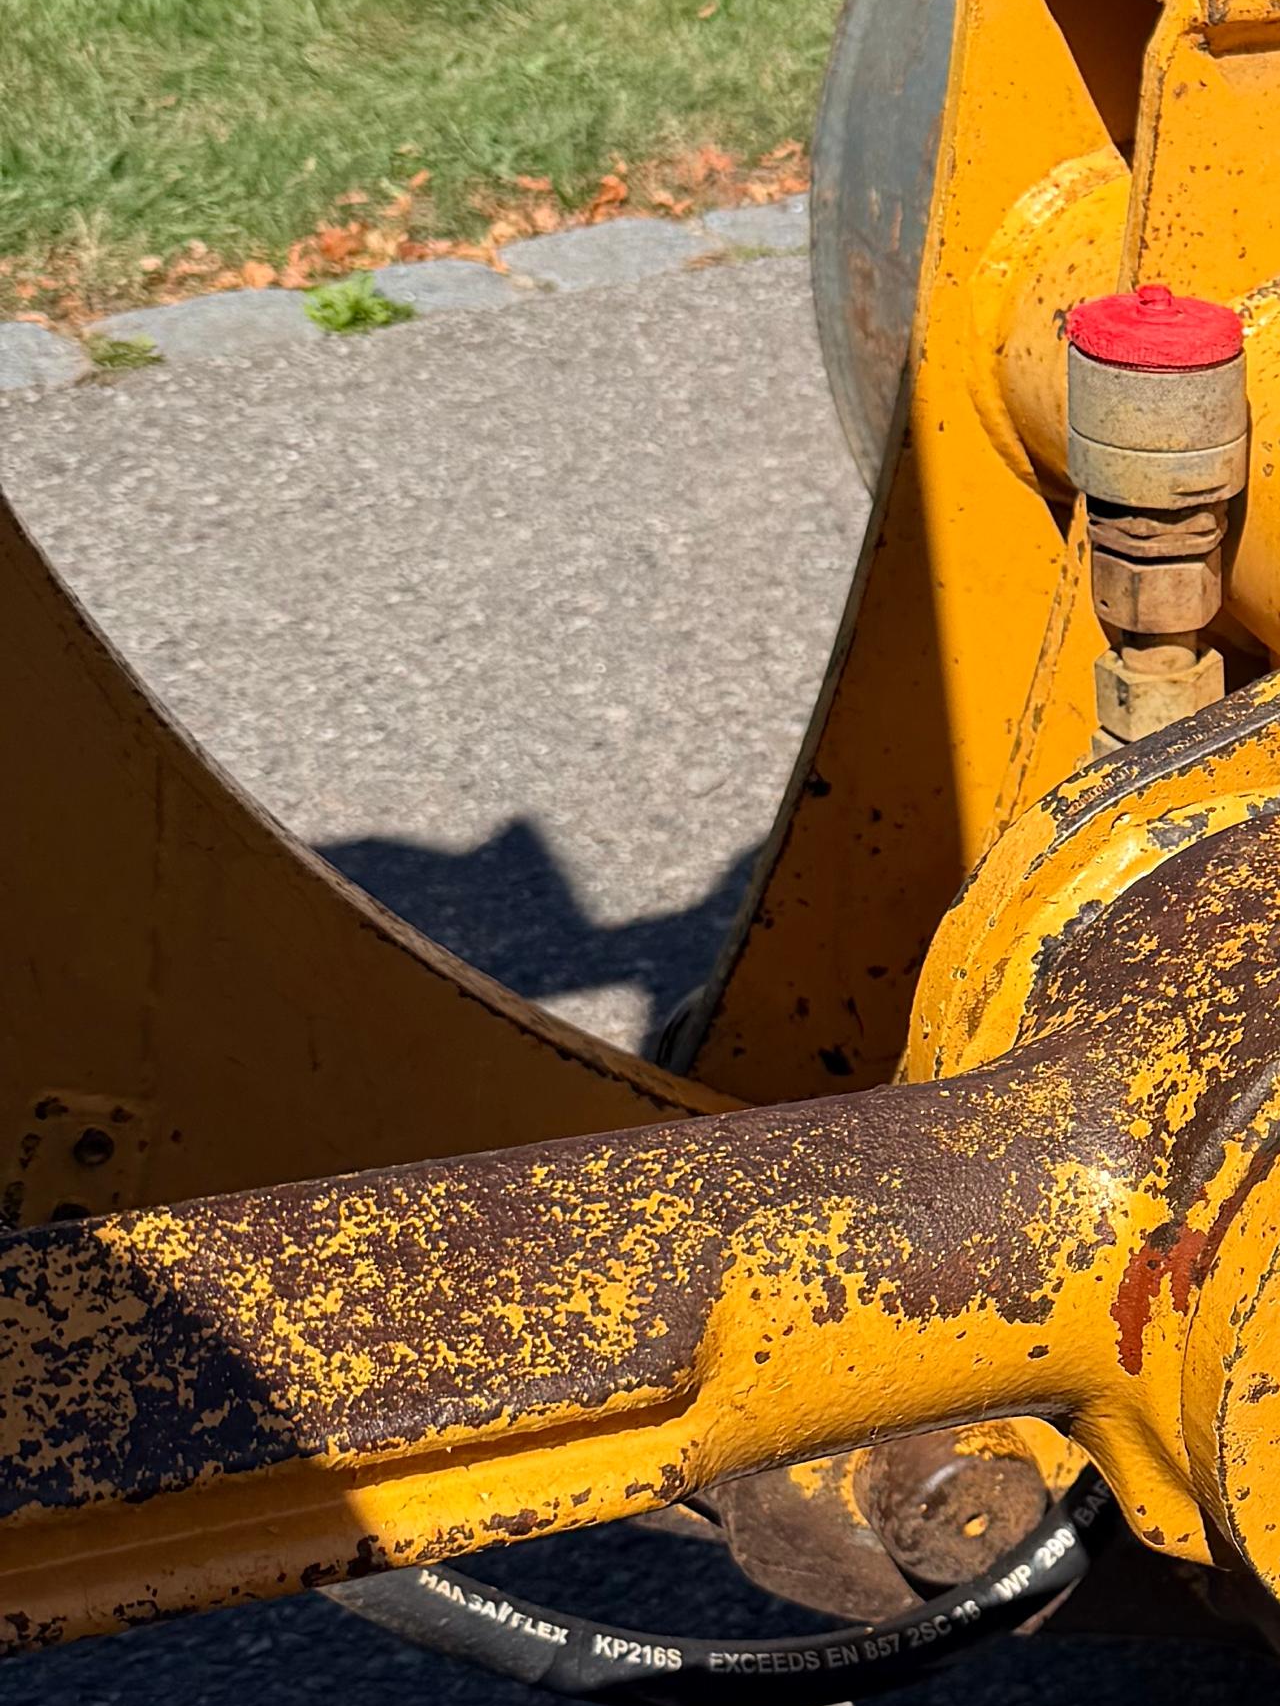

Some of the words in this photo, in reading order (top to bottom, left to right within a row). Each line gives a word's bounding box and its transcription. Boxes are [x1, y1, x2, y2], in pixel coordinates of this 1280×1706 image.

[591, 1633, 683, 1671] KP216S
[708, 1650, 821, 1674] EXCEEDS
[826, 1643, 860, 1669] EN
[864, 1632, 900, 1660] 857
[907, 1614, 953, 1646] 2SC
[991, 1564, 1032, 1601] WP
[1033, 1528, 1076, 1570] 290
